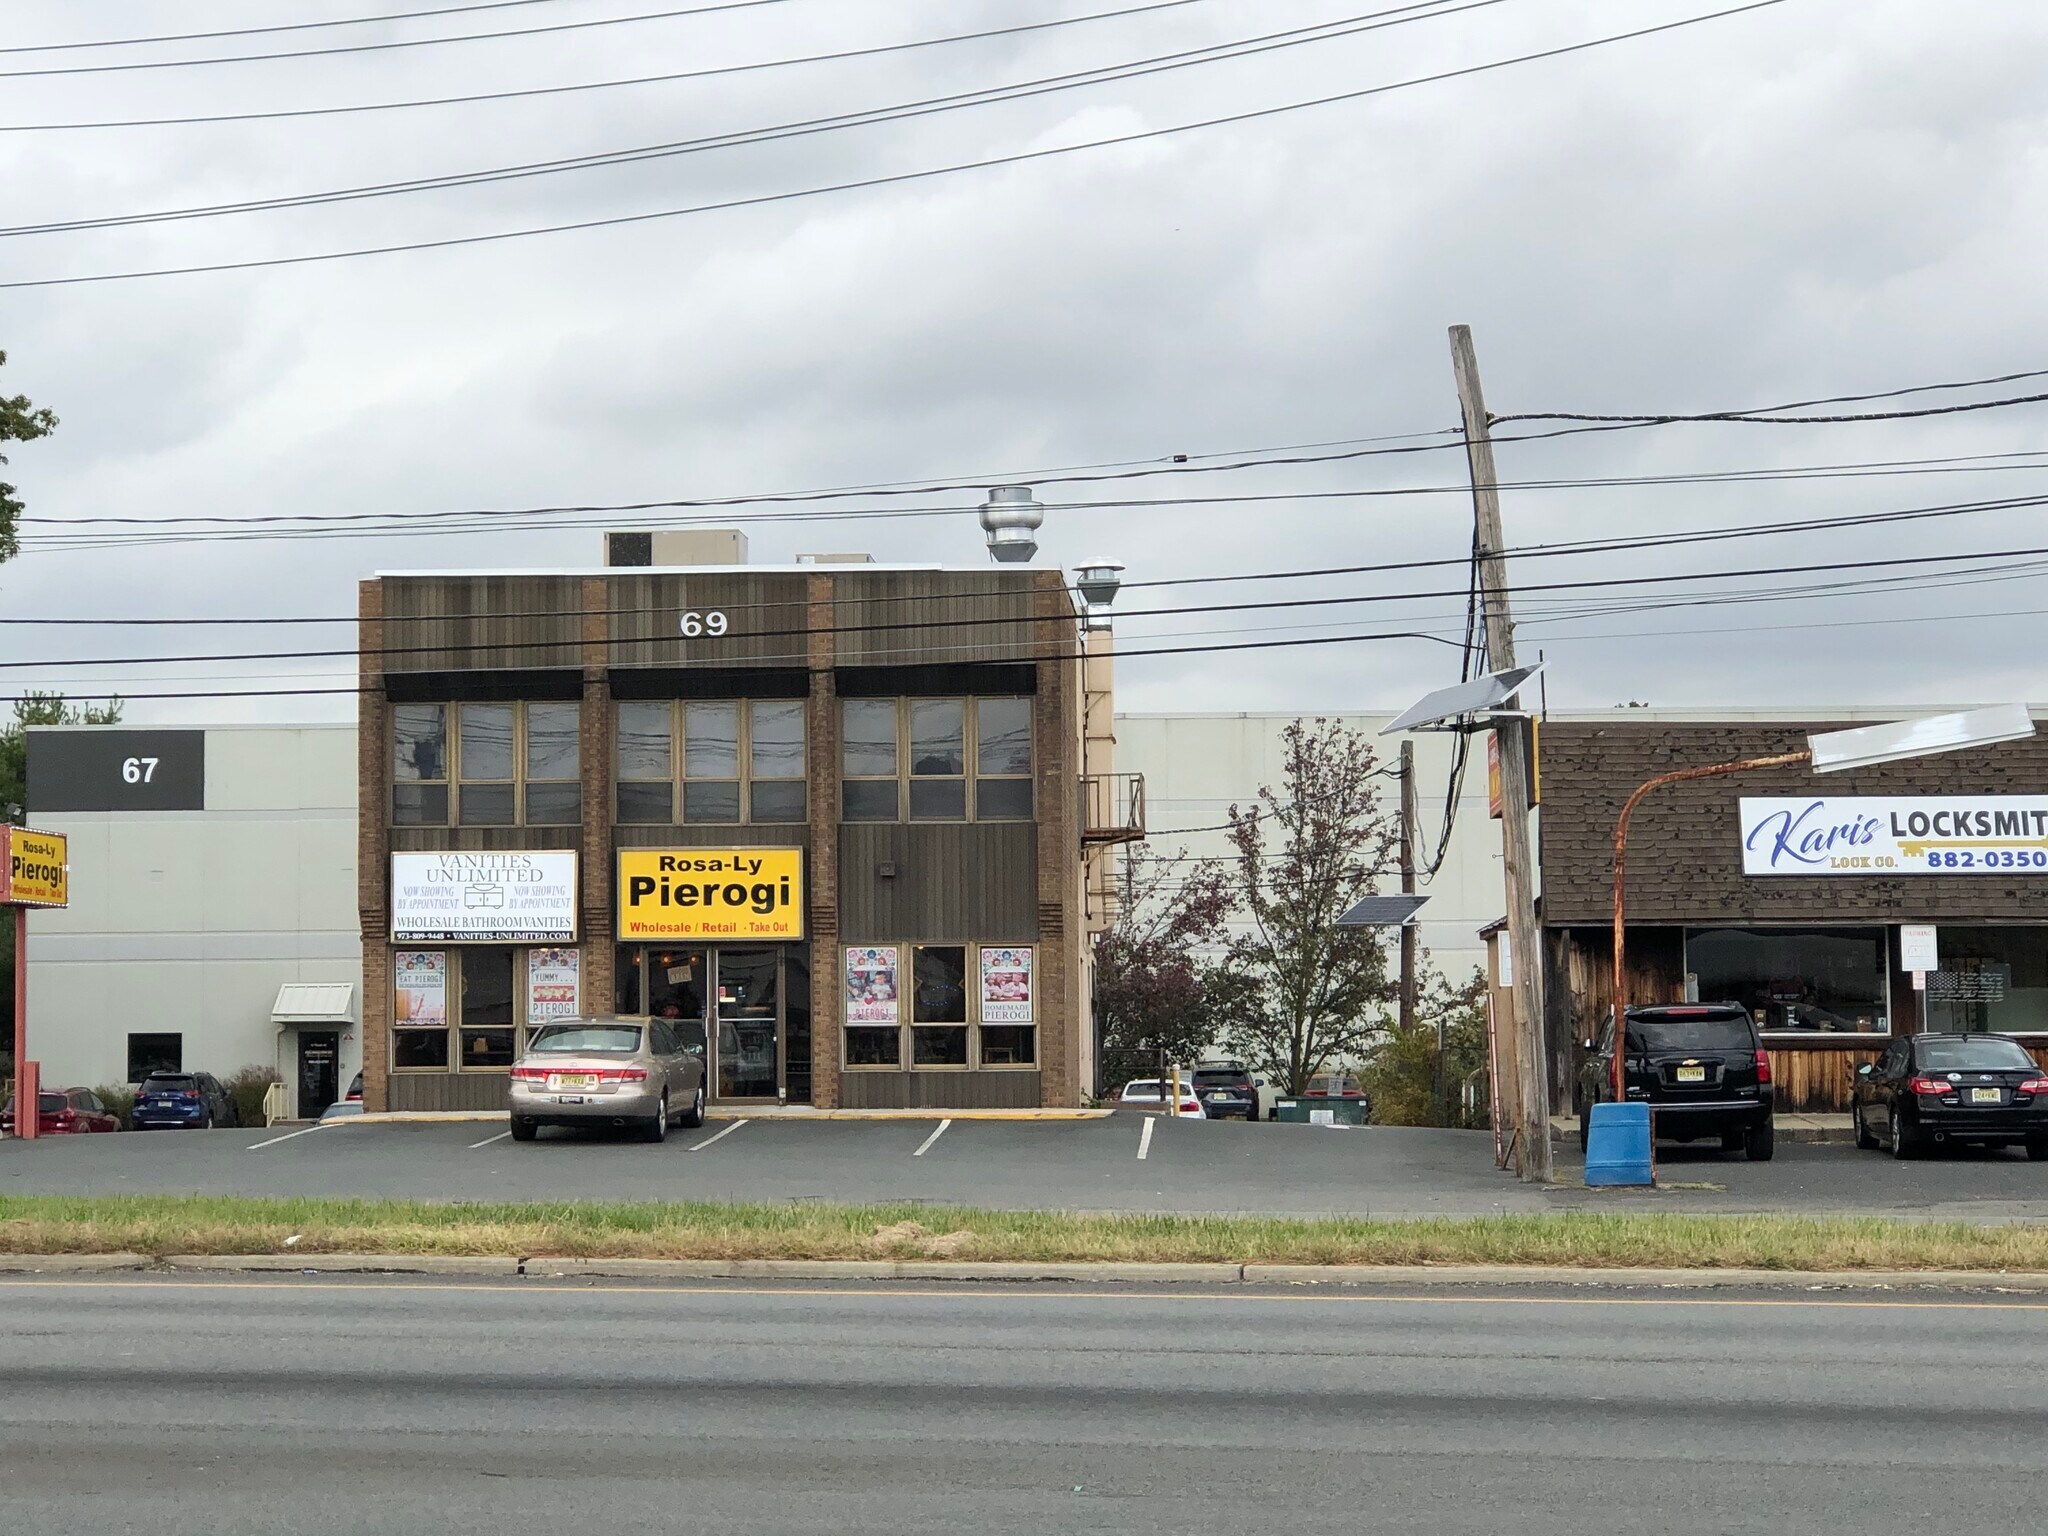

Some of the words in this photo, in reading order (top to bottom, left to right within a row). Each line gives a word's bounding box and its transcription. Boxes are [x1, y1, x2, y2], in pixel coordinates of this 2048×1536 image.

[680, 611, 728, 637] 69
[122, 757, 159, 784] 67
[1891, 810, 2048, 837] LOCKSMIT
[1746, 800, 1881, 867] Karis
[23, 840, 56, 859] Rosa-Ly
[439, 855, 531, 868] VANITIES
[1830, 856, 1870, 868] LOCK
[1874, 856, 1898, 868] CO.
[1927, 851, 2047, 867] 882-0350
[660, 856, 762, 875] Rosa-Ly
[12, 856, 62, 888] Pierogi
[427, 869, 543, 883] UNLIMITED
[403, 885, 419, 897] NOW
[420, 885, 454, 897] SHOWING
[514, 885, 530, 897] NOW
[530, 885, 566, 897] SHOWING
[630, 876, 790, 914] Pierogi
[397, 898, 409, 910] BY
[409, 898, 459, 910] APPOINTMENT
[508, 898, 519, 909] BY
[519, 897, 571, 909] APPOINTMENT
[397, 916, 460, 928] WHOLESALE
[462, 916, 522, 928] BATHROOM
[523, 916, 571, 928] VANITIES
[630, 921, 691, 933] Wholesale
[702, 921, 737, 933] Retail
[749, 921, 770, 933] Take
[773, 921, 788, 933] Out
[452, 932, 570, 940] VANITIES-UNLIMITED.COM
[399, 975, 412, 983] EAT
[415, 975, 442, 983] PIEROGI
[533, 1003, 575, 1014] PIEROGI
[856, 1008, 889, 1018] PIEROGI
[984, 1011, 1030, 1020] PIEROGI
